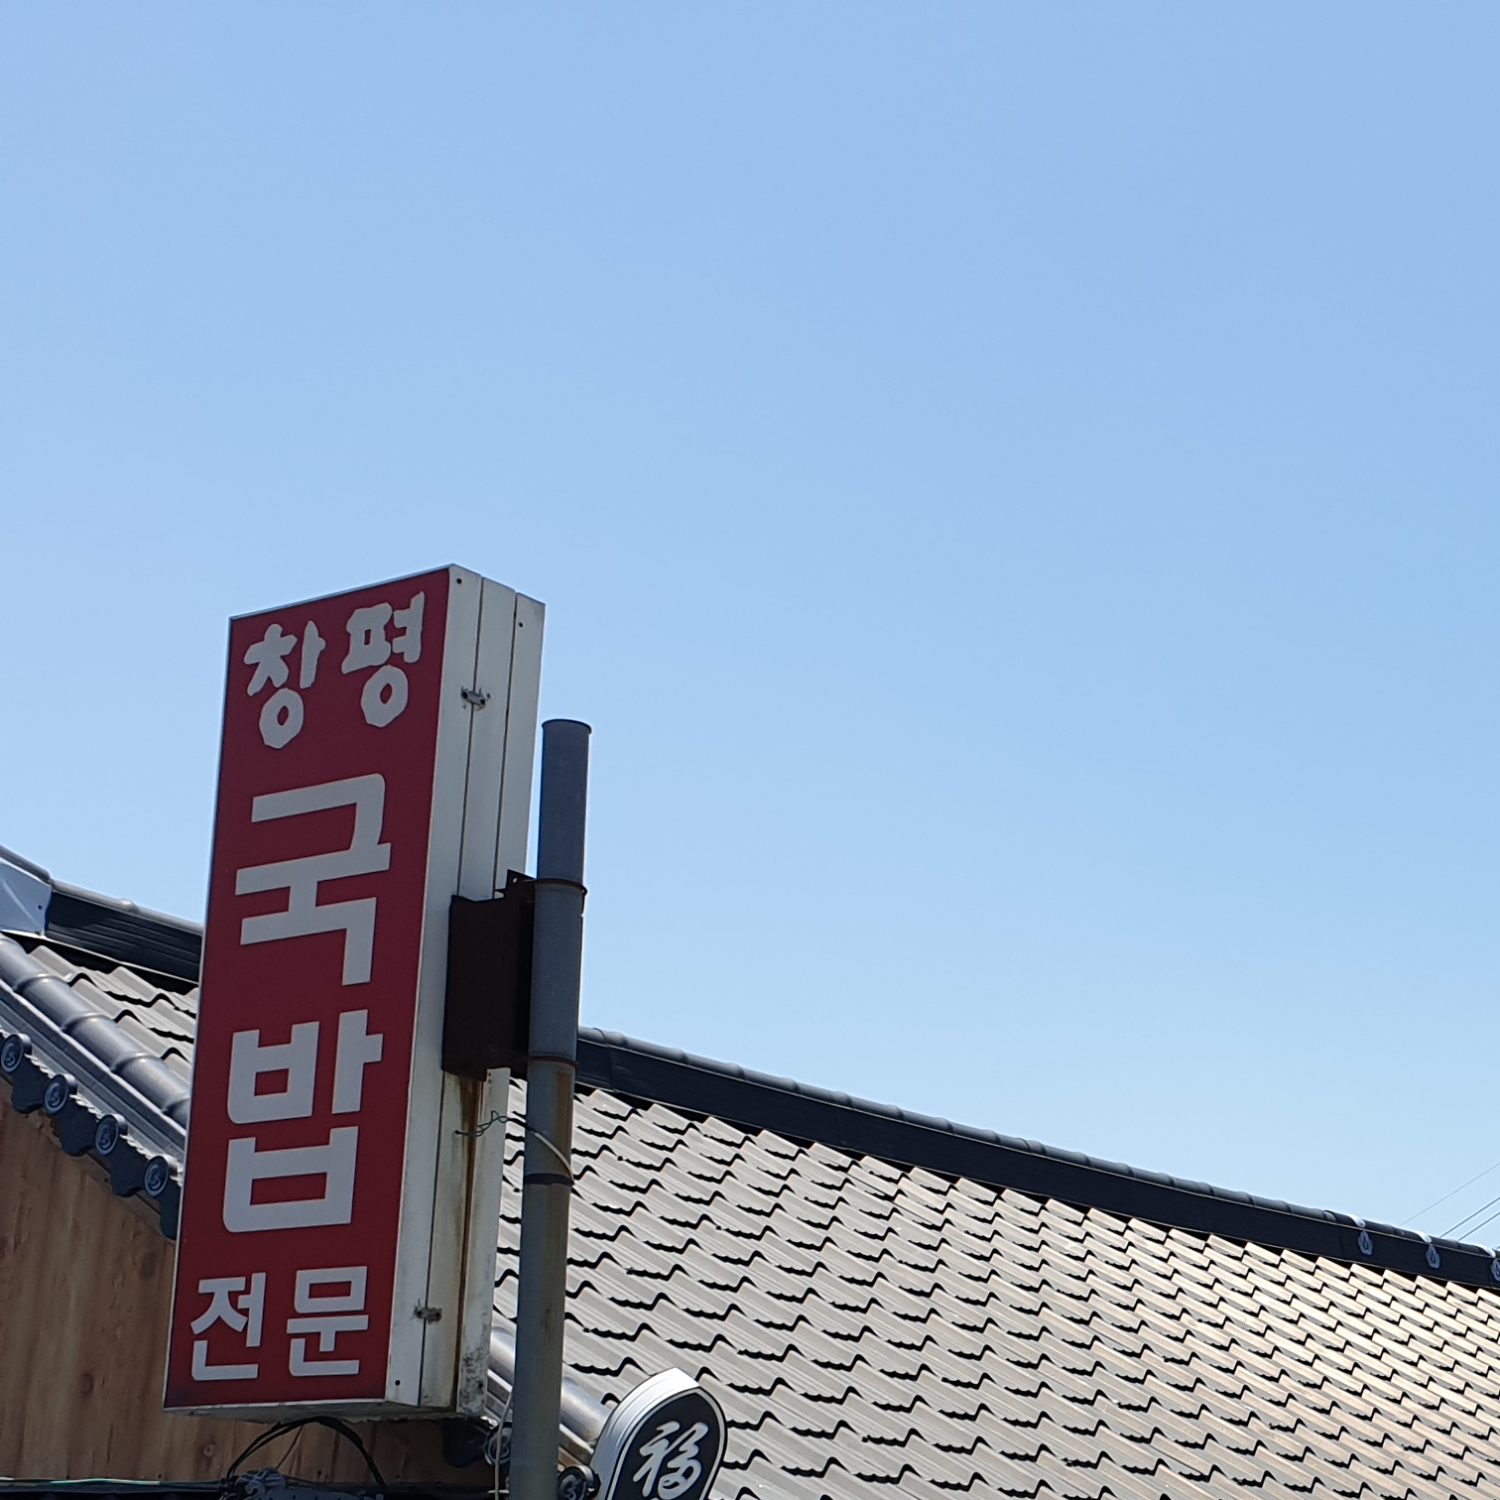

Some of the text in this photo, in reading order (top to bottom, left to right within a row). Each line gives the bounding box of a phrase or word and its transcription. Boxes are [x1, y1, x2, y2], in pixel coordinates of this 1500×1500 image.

[242, 591, 427, 750] 창평
[222, 772, 391, 1235] 국밥
[190, 1264, 371, 1382] 전문
